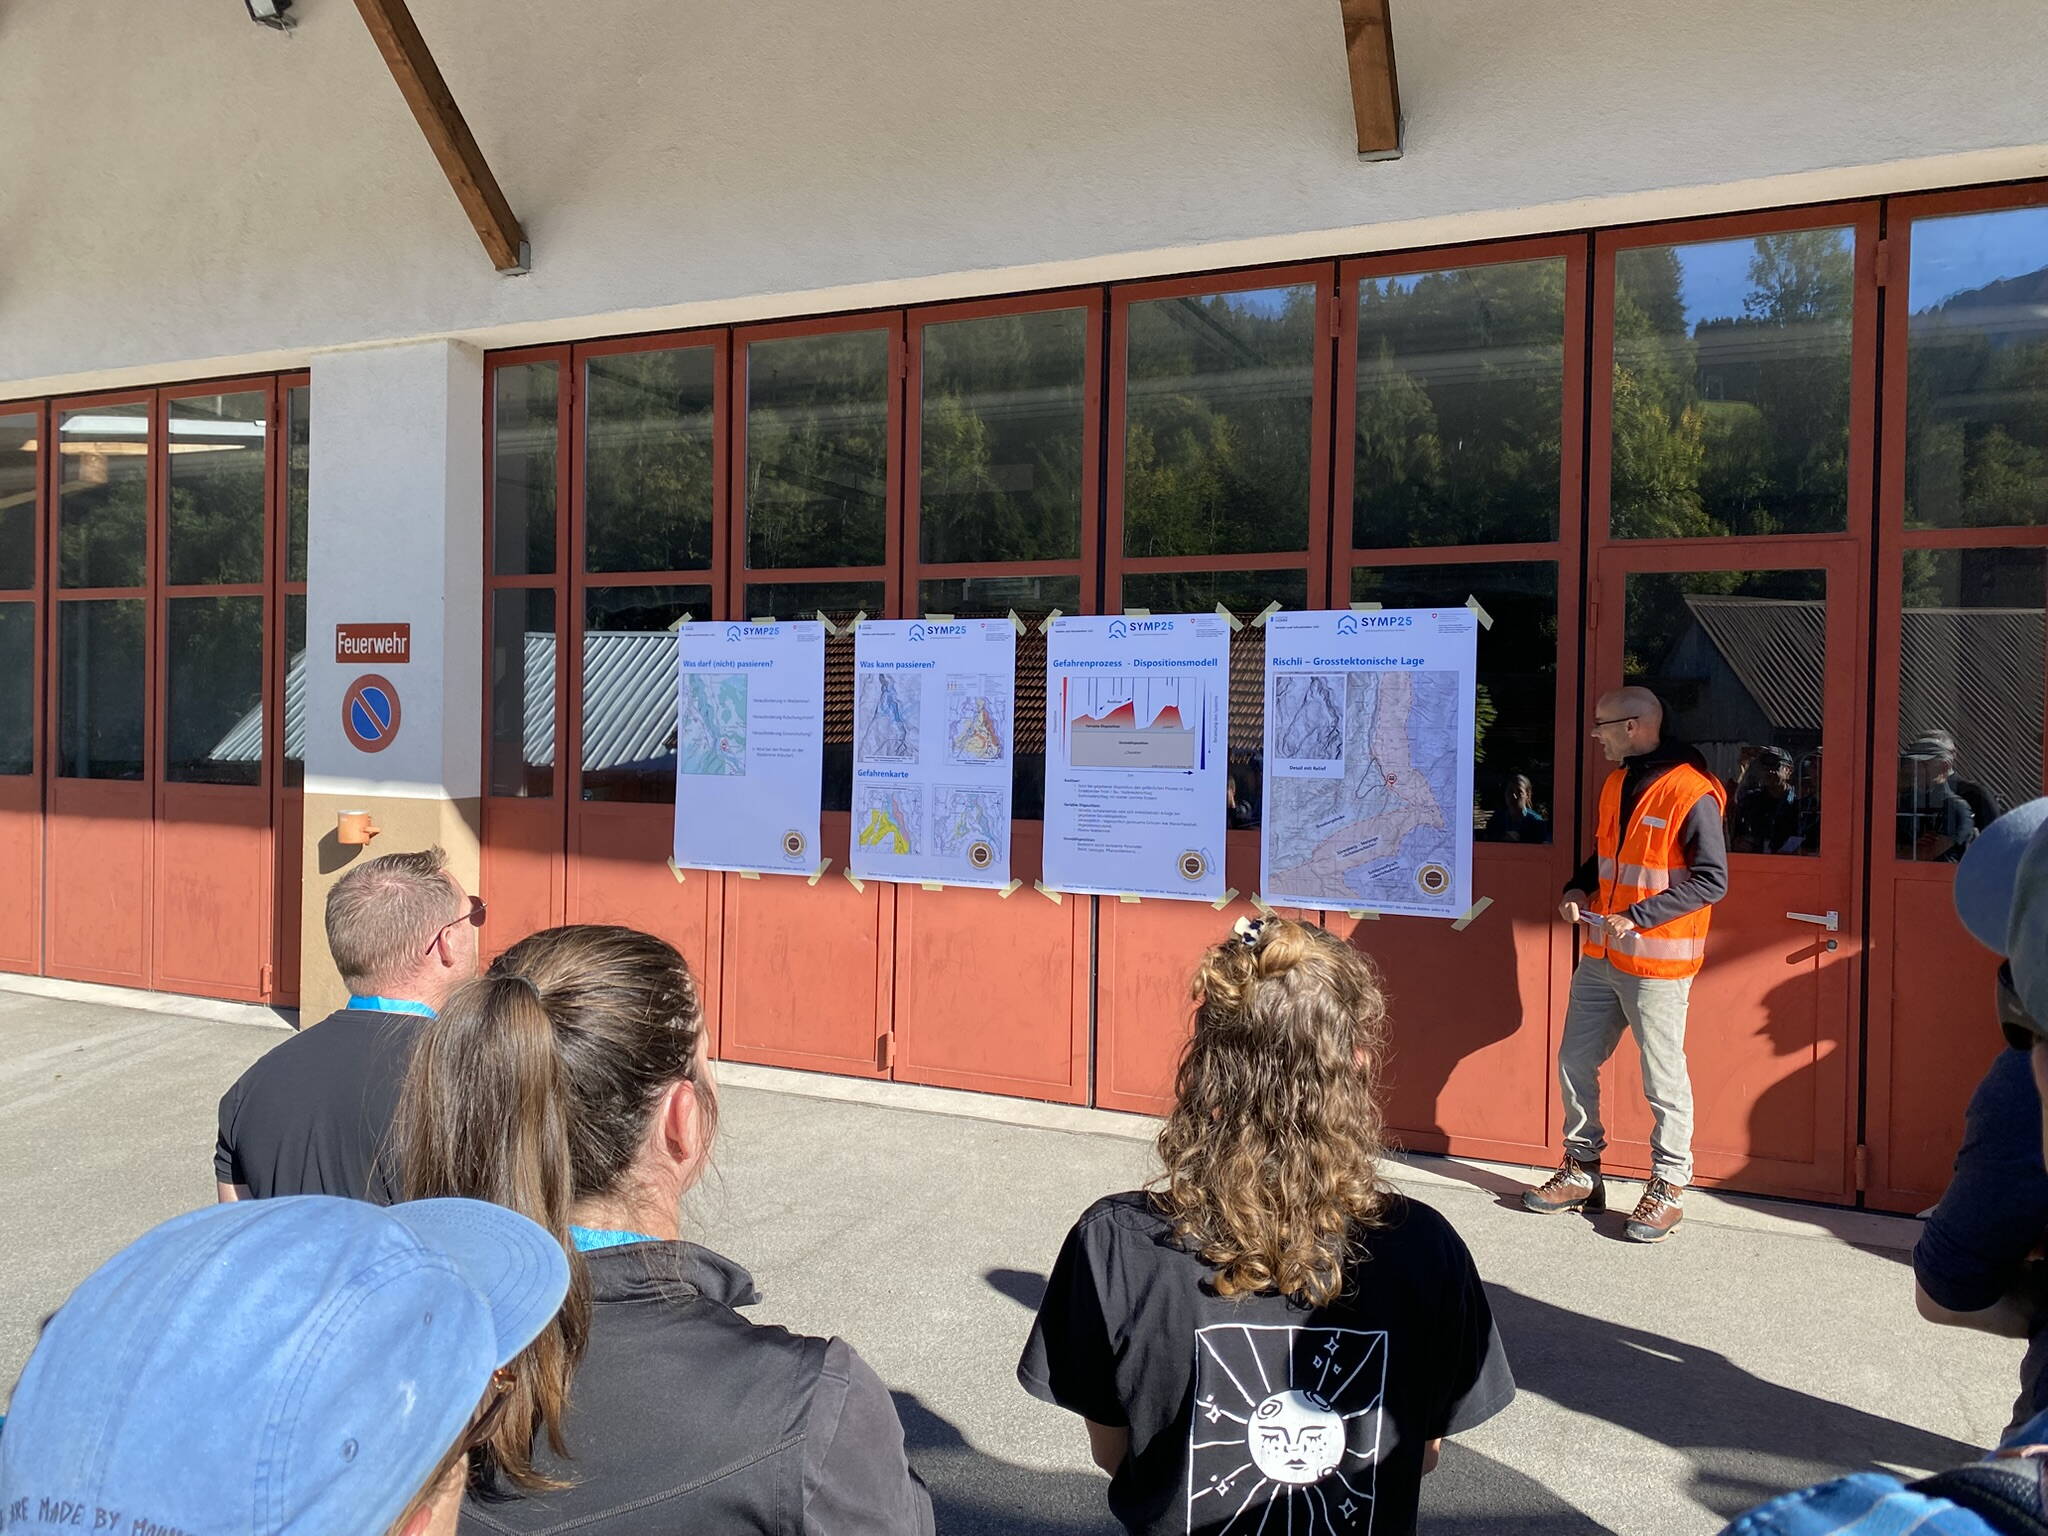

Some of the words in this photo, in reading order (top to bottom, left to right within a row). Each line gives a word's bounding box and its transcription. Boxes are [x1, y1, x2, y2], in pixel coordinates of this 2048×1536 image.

[1129, 621, 1174, 631] SYMP25
[1361, 616, 1413, 627] SYMP25
[743, 626, 780, 636] SYMP25
[927, 625, 967, 635] SYMP25
[337, 631, 408, 654] Feuerwehr
[683, 660, 696, 668] Was
[697, 660, 712, 668] darf
[713, 660, 736, 669] (nicht)
[737, 660, 774, 671] passieren?
[859, 660, 875, 668] Was
[876, 660, 894, 668] kann
[895, 660, 936, 670] passieren?
[1053, 659, 1122, 669] Gefahrenprozess
[1133, 658, 1218, 669] Dispositionsmodell
[1272, 657, 1302, 666] Rischli
[1313, 657, 1398, 666] Grosstektonische
[1401, 657, 1425, 668] Lage
[857, 769, 909, 779] Gefahrenkarte
[39, 1496, 84, 1525] MADE
[95, 1507, 120, 1530] BY
